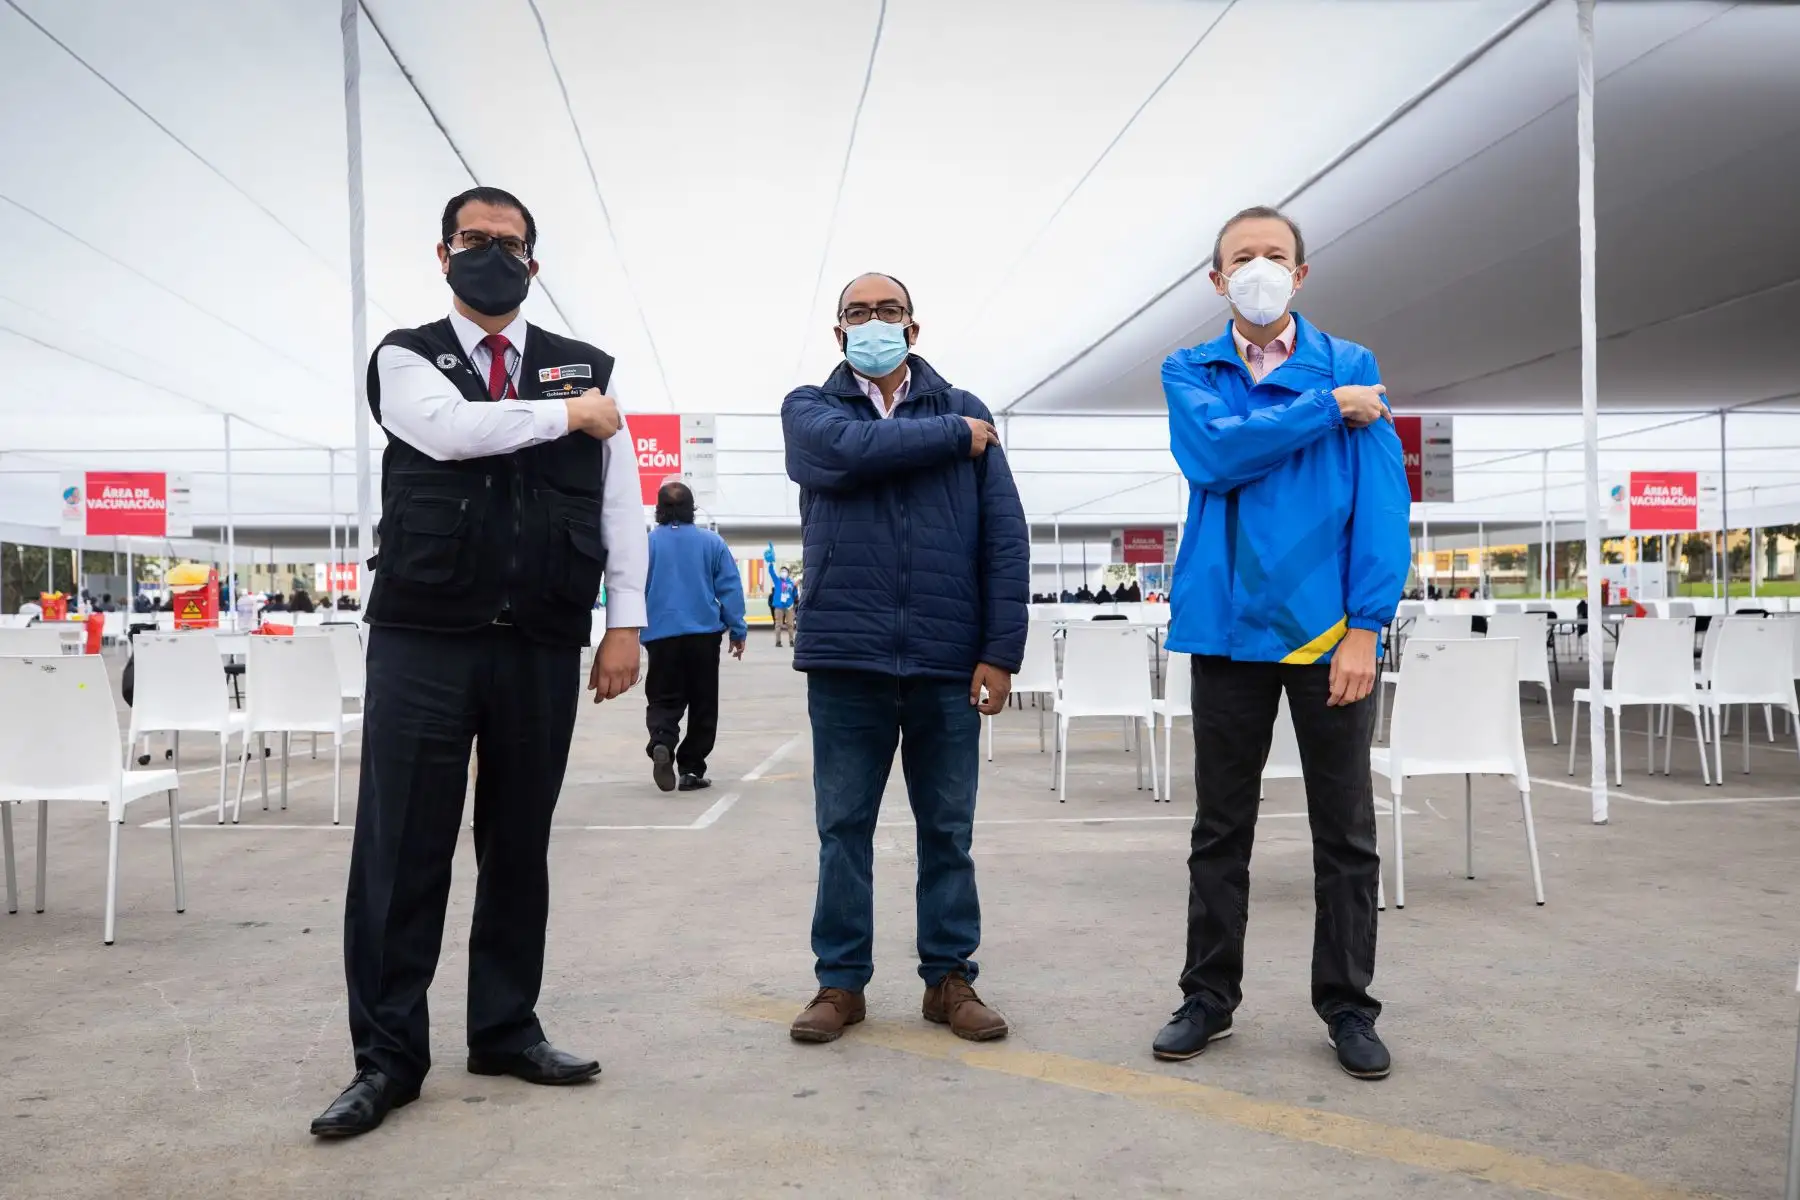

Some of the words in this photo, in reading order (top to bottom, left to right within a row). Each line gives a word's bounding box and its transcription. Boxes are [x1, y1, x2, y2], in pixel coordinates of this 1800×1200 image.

[637, 438, 657, 452] DE
[637, 449, 680, 468] CIÓN
[102, 485, 133, 499] ÁREA
[134, 487, 150, 499] DE
[1643, 484, 1669, 496] ÁREA
[1670, 486, 1683, 496] DE
[87, 496, 165, 510] VACUNACIÓN
[1631, 495, 1696, 506] VACUNACIÓN
